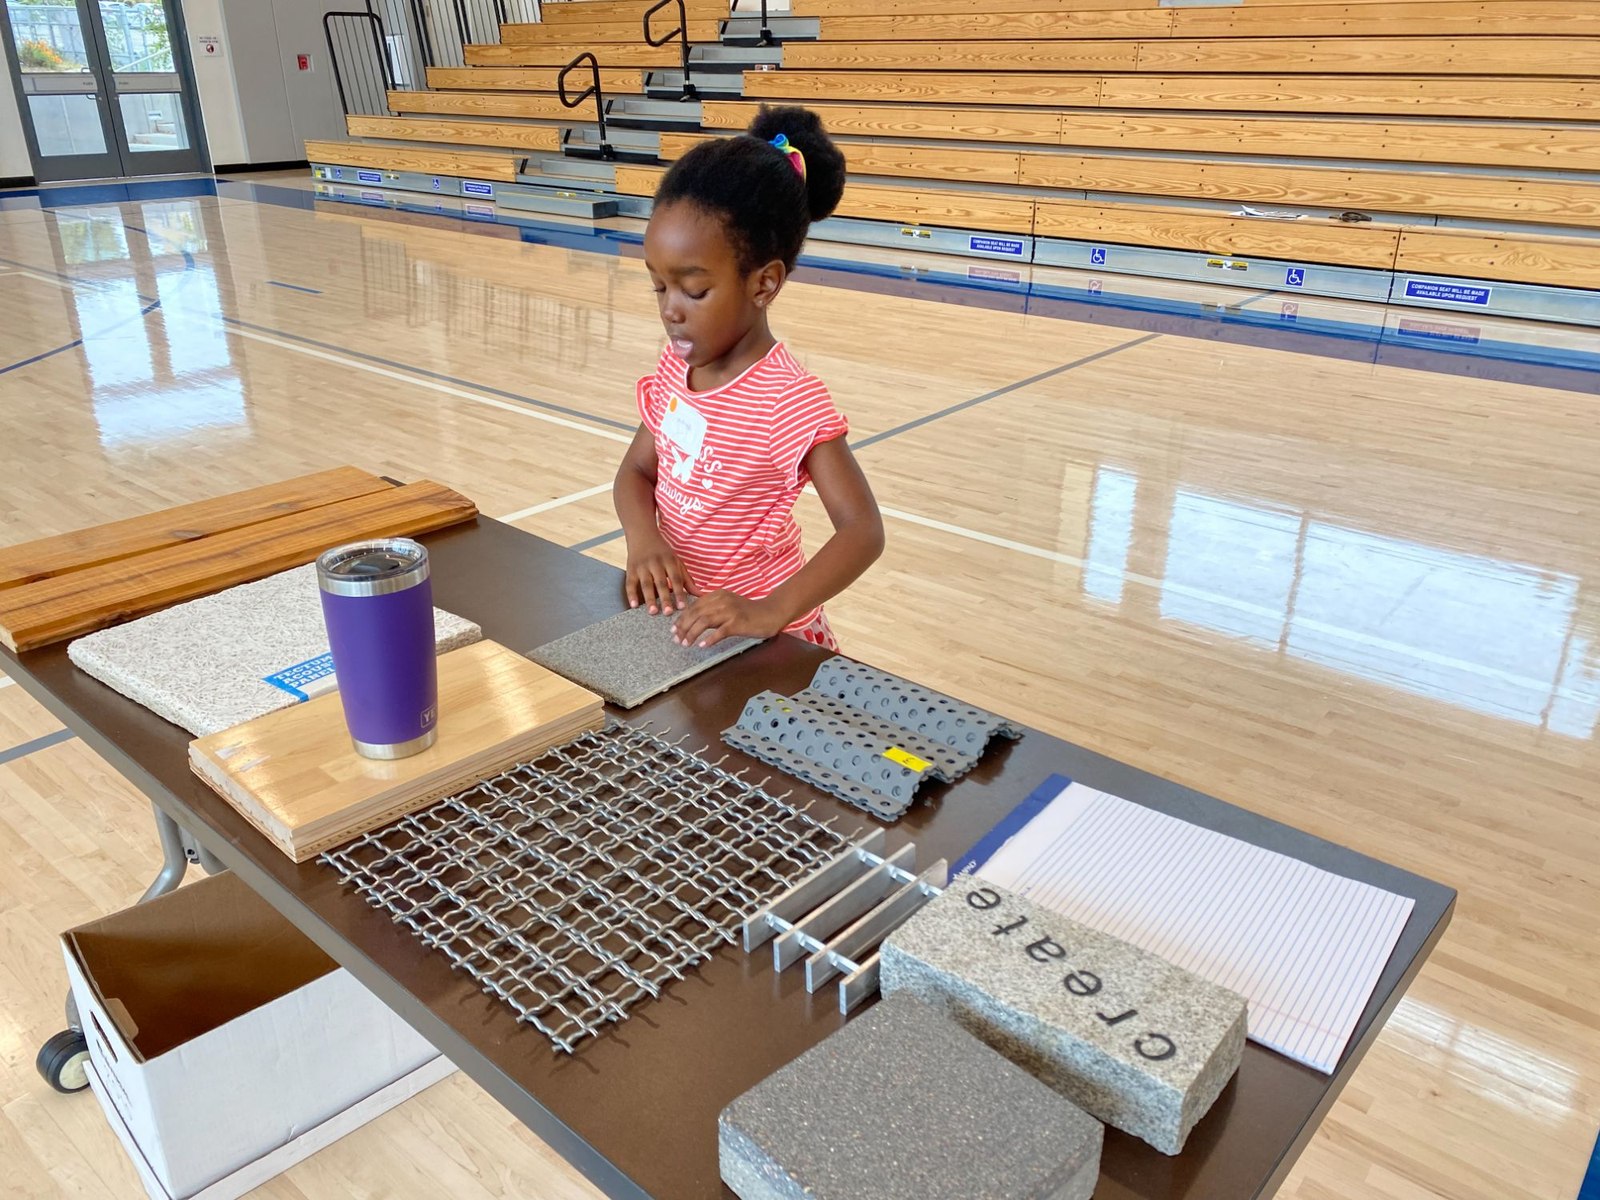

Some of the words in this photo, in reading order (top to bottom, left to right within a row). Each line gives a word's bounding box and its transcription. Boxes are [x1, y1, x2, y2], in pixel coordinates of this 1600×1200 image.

[1411, 283, 1438, 291] COMPANION
[660, 476, 704, 515] always
[965, 886, 1177, 1062] create
